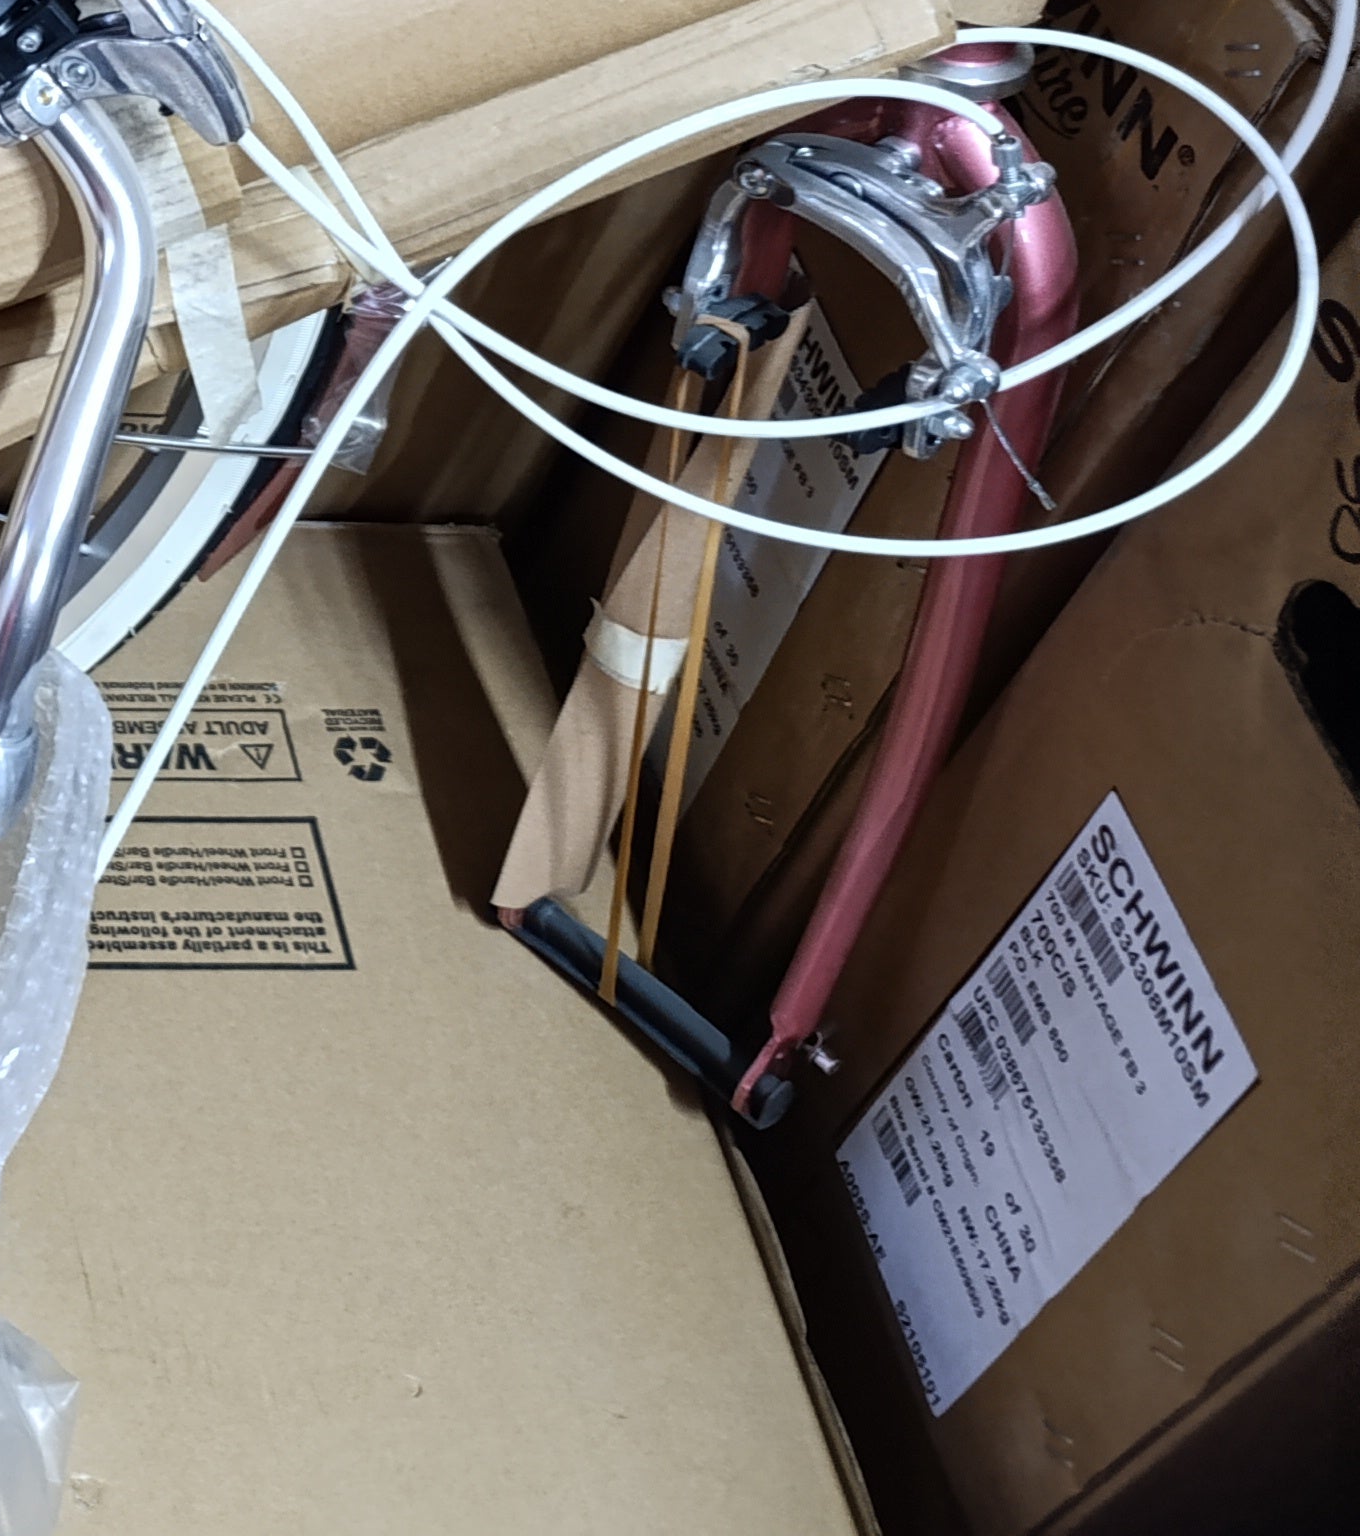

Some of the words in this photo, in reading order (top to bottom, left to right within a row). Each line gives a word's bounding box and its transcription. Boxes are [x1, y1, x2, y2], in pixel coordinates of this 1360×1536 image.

[322, 709, 382, 718] MATERIAL
[203, 720, 269, 736] ADULT
[325, 718, 384, 727] RECYCLED
[1076, 847, 1112, 914] SKU:
[89, 922, 170, 939] following
[171, 922, 202, 940] the
[205, 926, 223, 939] of
[226, 922, 327, 940] attachment
[181, 938, 254, 954] partially
[256, 940, 269, 951] a
[271, 940, 290, 954] is
[291, 940, 333, 954] This
[1090, 824, 1225, 1075] SCHWINN
[1045, 890, 1066, 927] 700
[1062, 927, 1077, 948] M
[1074, 948, 1123, 1045] VANTAGE
[973, 985, 1000, 1032] UPC
[937, 1033, 974, 1109] Carton
[984, 1204, 1022, 1284] CHINA
